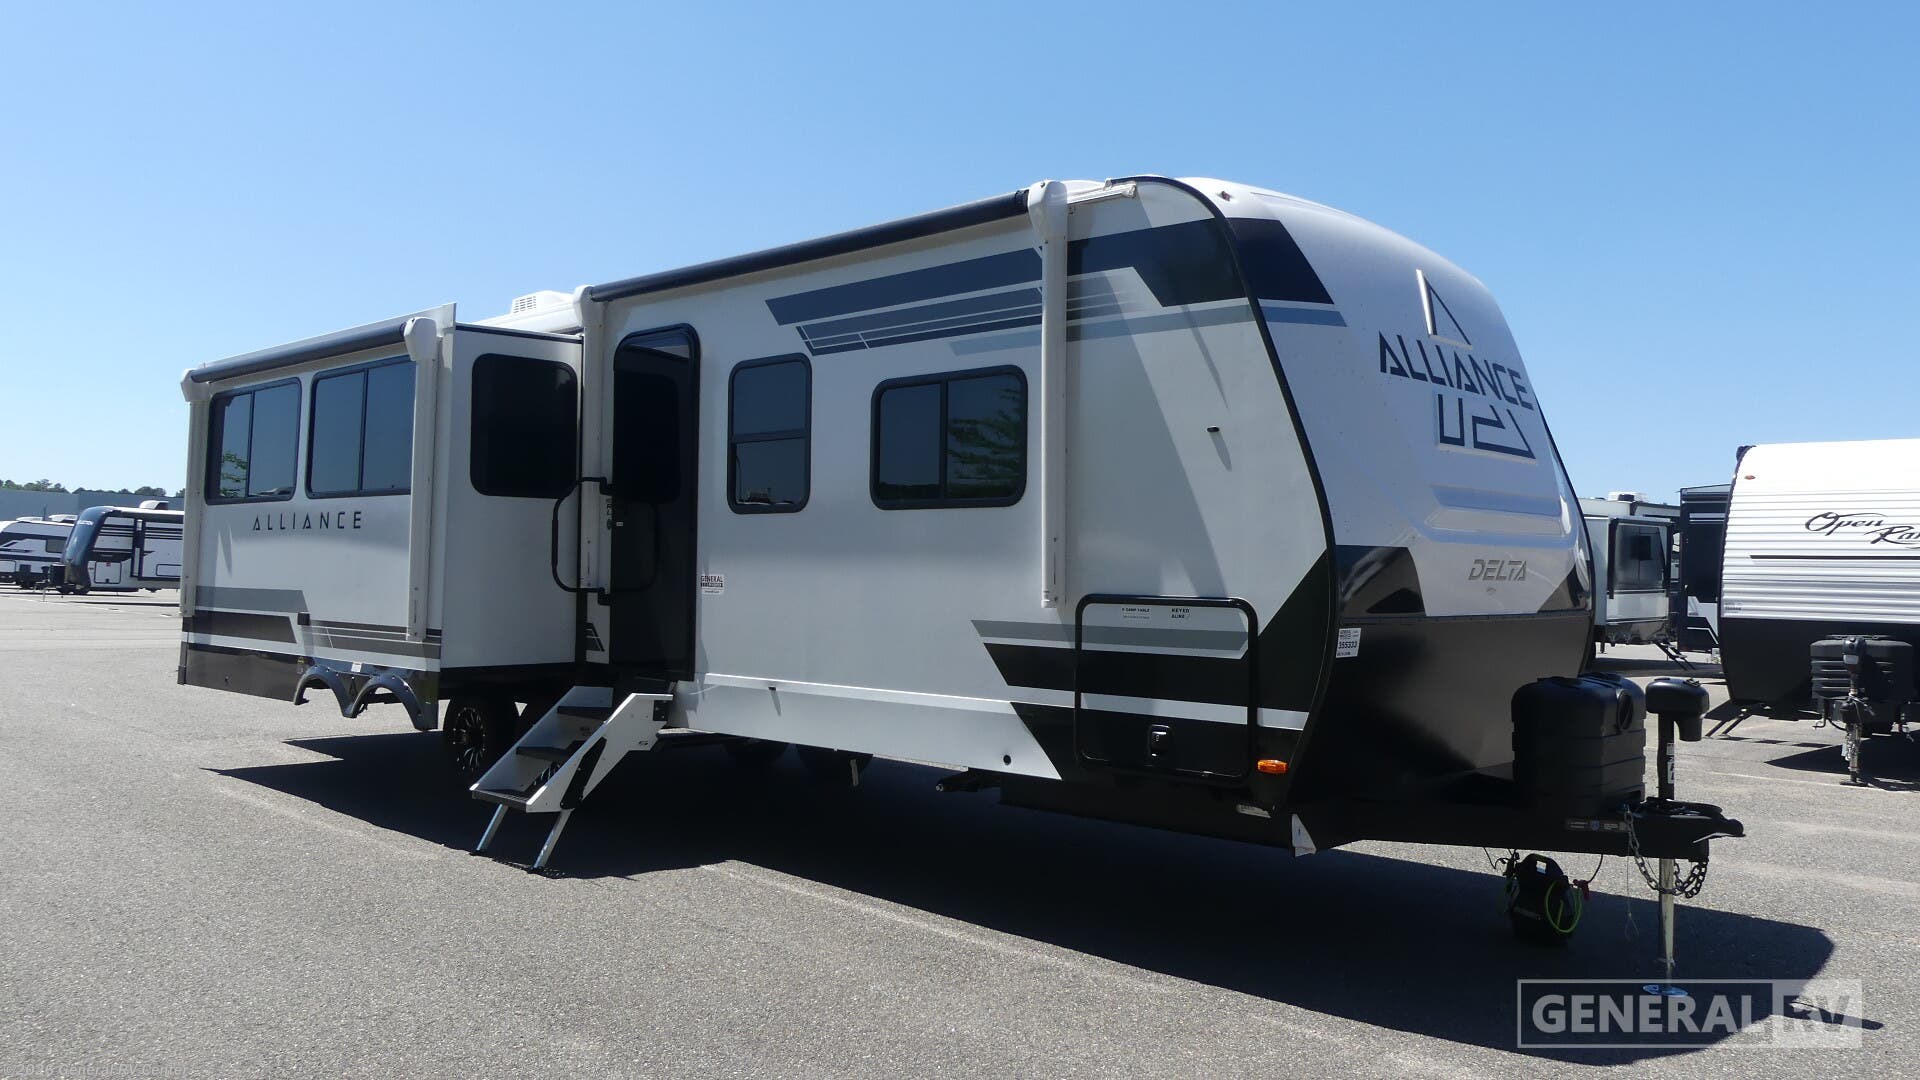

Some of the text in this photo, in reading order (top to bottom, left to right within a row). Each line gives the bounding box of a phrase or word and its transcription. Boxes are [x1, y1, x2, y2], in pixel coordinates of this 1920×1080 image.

[1379, 330, 1534, 410] ALLIANCE
[252, 511, 362, 531] ALLIANCE
[1805, 512, 1887, 536] Open
[1468, 559, 1527, 582] DELTA
